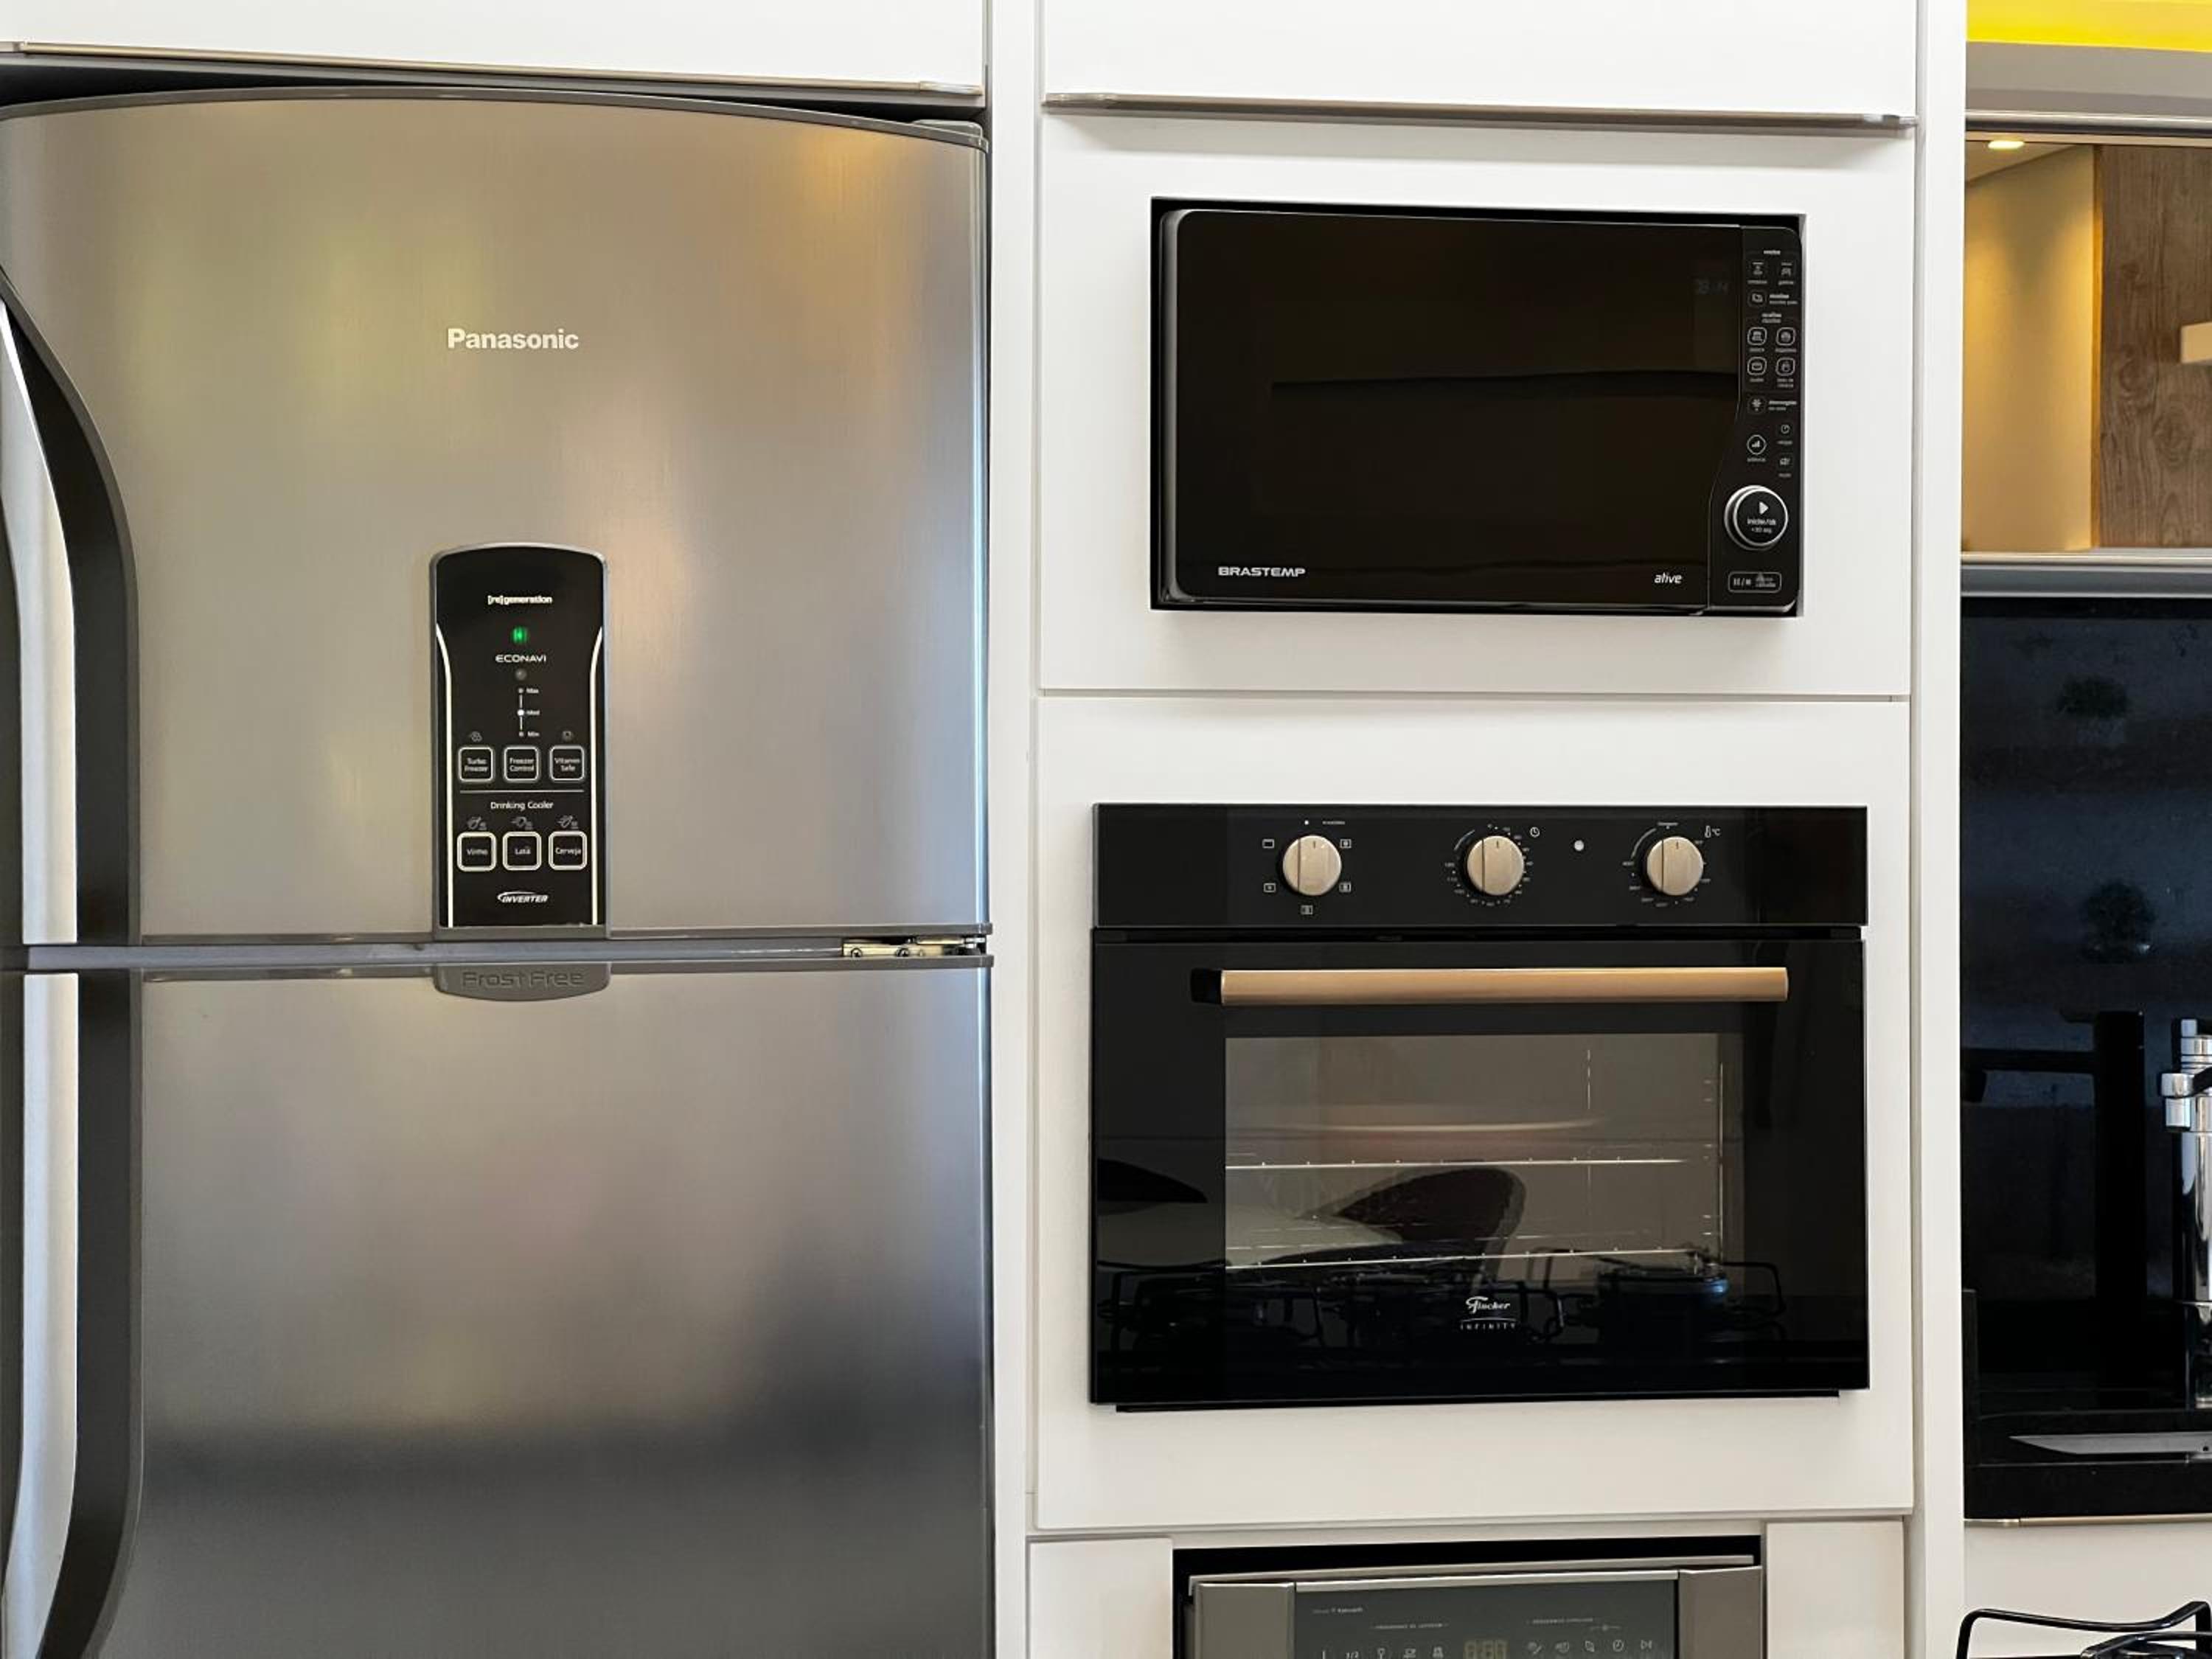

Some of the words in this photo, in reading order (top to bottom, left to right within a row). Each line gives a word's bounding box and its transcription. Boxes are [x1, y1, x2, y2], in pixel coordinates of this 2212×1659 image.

[448, 328, 579, 349] Panasonic
[1218, 567, 1306, 577] BRASTEMP
[495, 654, 546, 663] ECONAVI
[465, 765, 489, 773] Freezer
[509, 764, 534, 772] Control
[490, 801, 525, 811] Drinking
[527, 801, 554, 810] Cooler
[467, 847, 488, 856] Vinho
[554, 846, 582, 857] Cerveja
[500, 893, 549, 903] INVERTER
[462, 970, 523, 987] Frost
[529, 970, 585, 987] Free
